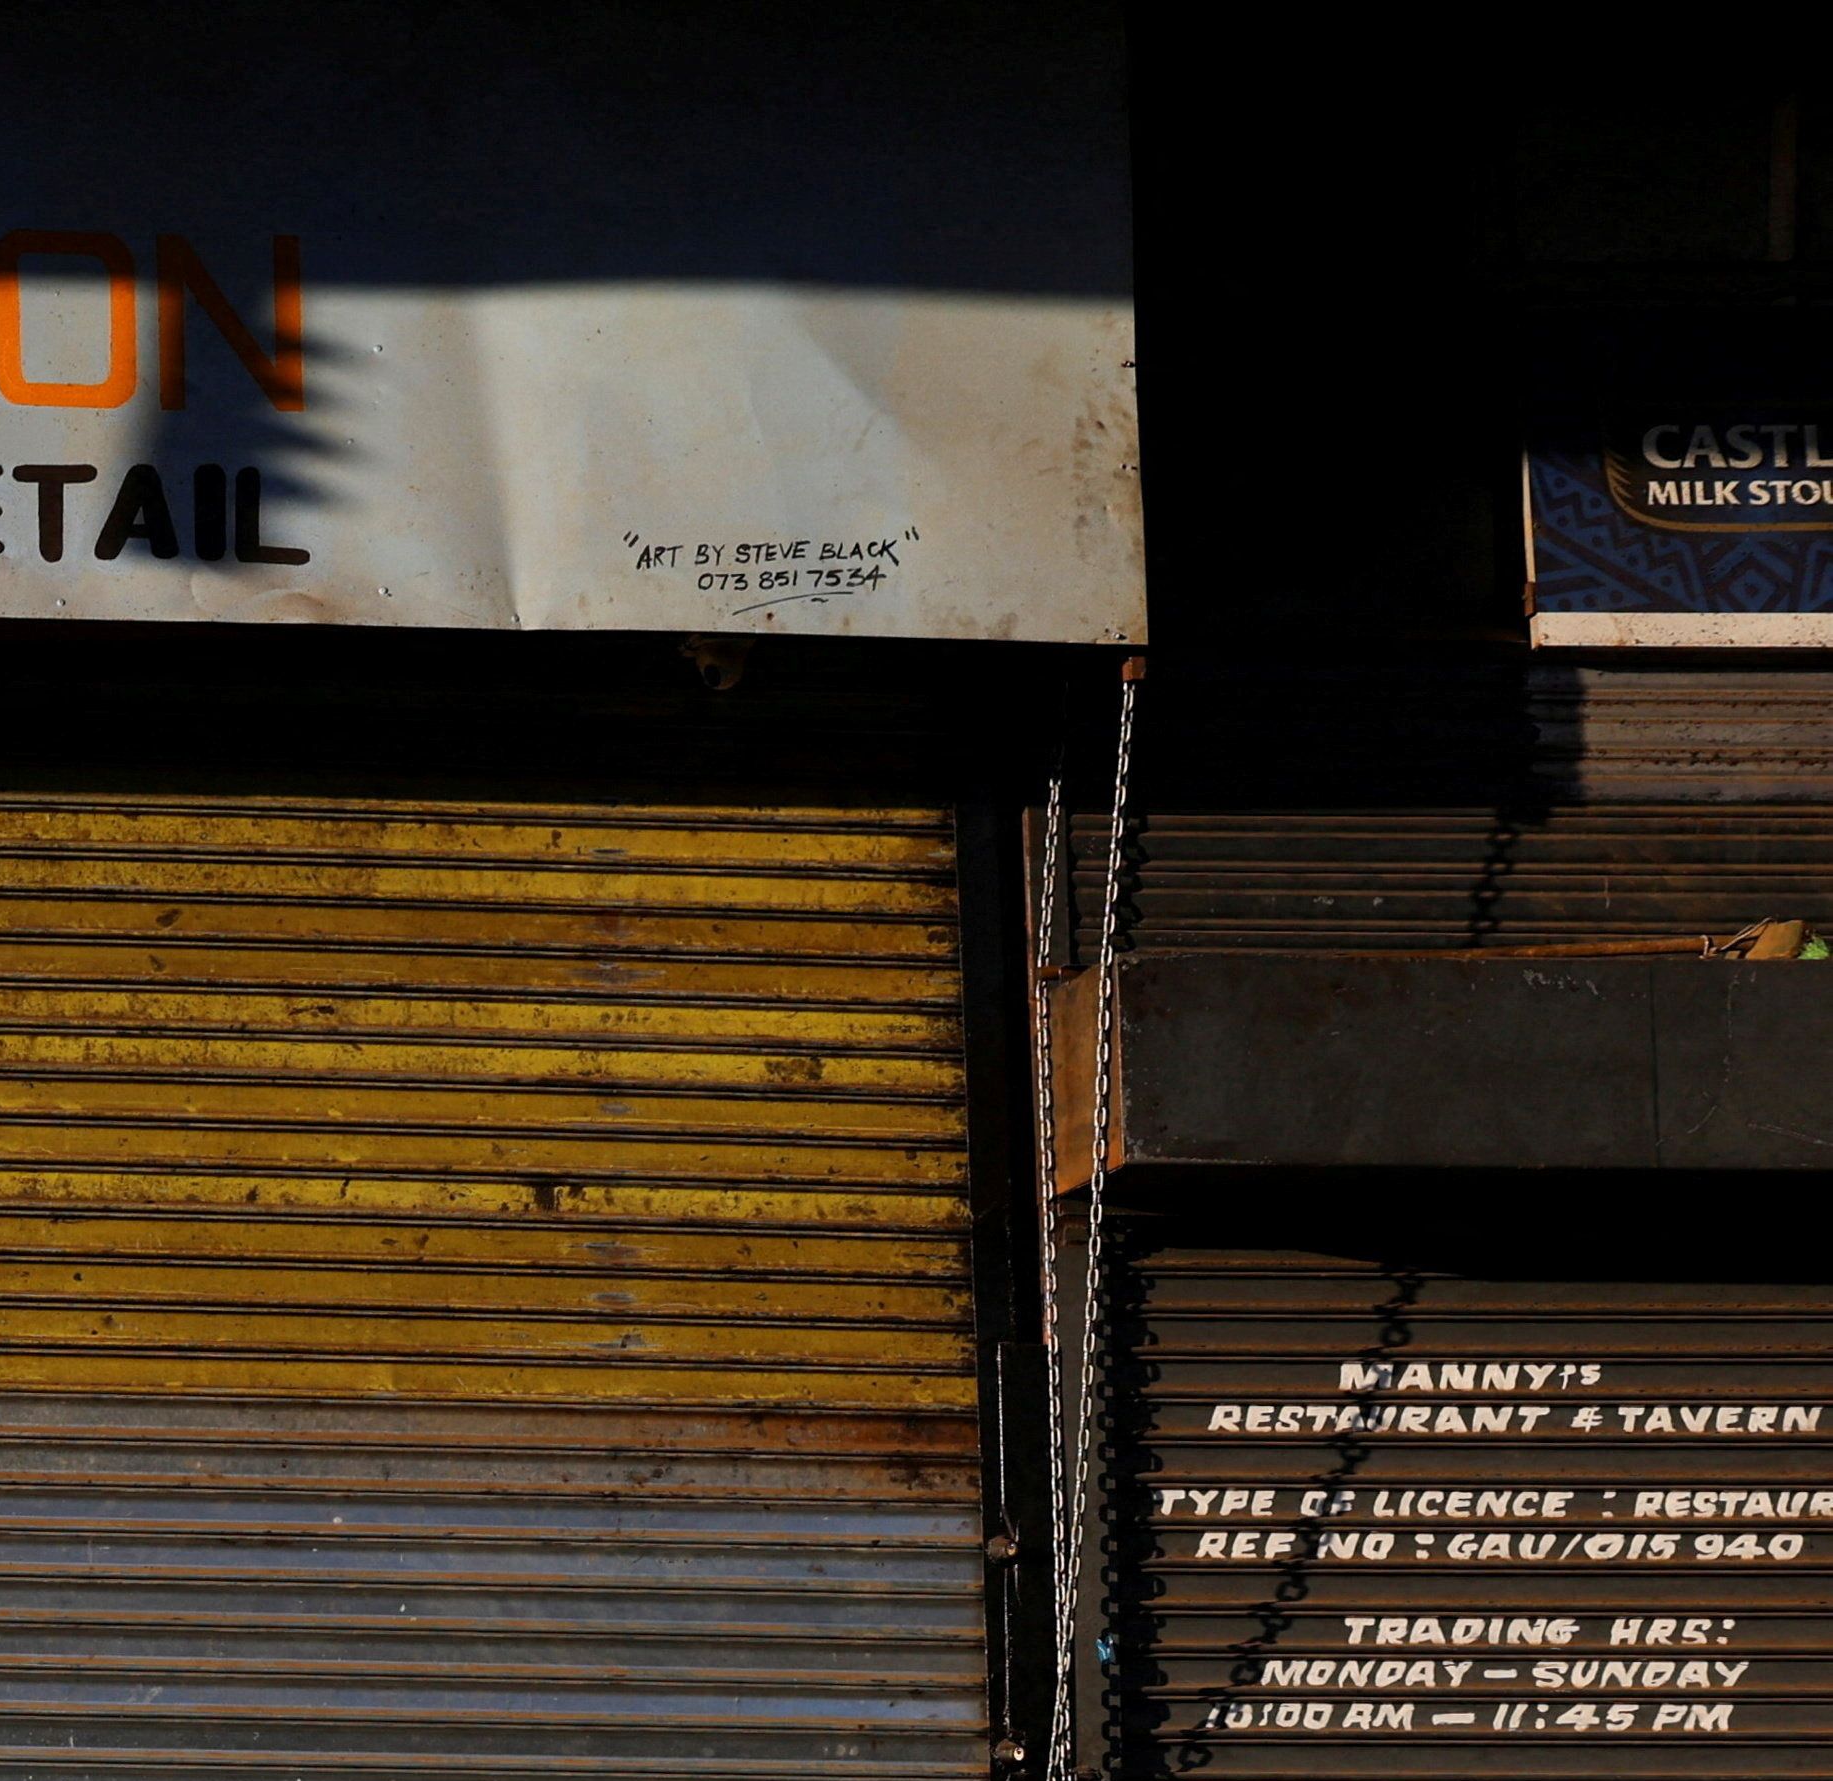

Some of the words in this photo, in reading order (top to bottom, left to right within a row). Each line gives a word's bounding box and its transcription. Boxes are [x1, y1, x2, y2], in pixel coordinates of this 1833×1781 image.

[1641, 423, 1833, 469] CASTL
[1647, 479, 1742, 506] MILK
[695, 544, 725, 566] BY
[735, 541, 810, 563] STEVE
[698, 573, 748, 591] 073
[759, 571, 797, 589] 851
[807, 566, 886, 591] 7534
[1207, 1404, 1551, 1434] RESTAURANT
[1569, 1405, 1604, 1434] &
[1616, 1404, 1822, 1434] TAVERN
[1155, 1489, 1275, 1518] TYPE
[1299, 1489, 1357, 1518] OF
[1372, 1489, 1574, 1519] LICENCE
[1632, 1491, 1833, 1520] RESTAUR
[1195, 1532, 1296, 1560] REF
[1317, 1532, 1395, 1560] NO
[1692, 1532, 1805, 1562] 940
[1344, 1617, 1582, 1646] TRADING
[1259, 1659, 1474, 1690] MONDAY
[1532, 1660, 1749, 1690] SUNDAY
[1204, 1702, 1334, 1731] 10:00
[1341, 1702, 1414, 1731] AM
[1491, 1702, 1640, 1731] 11:45
[1650, 1702, 1734, 1732] PM
